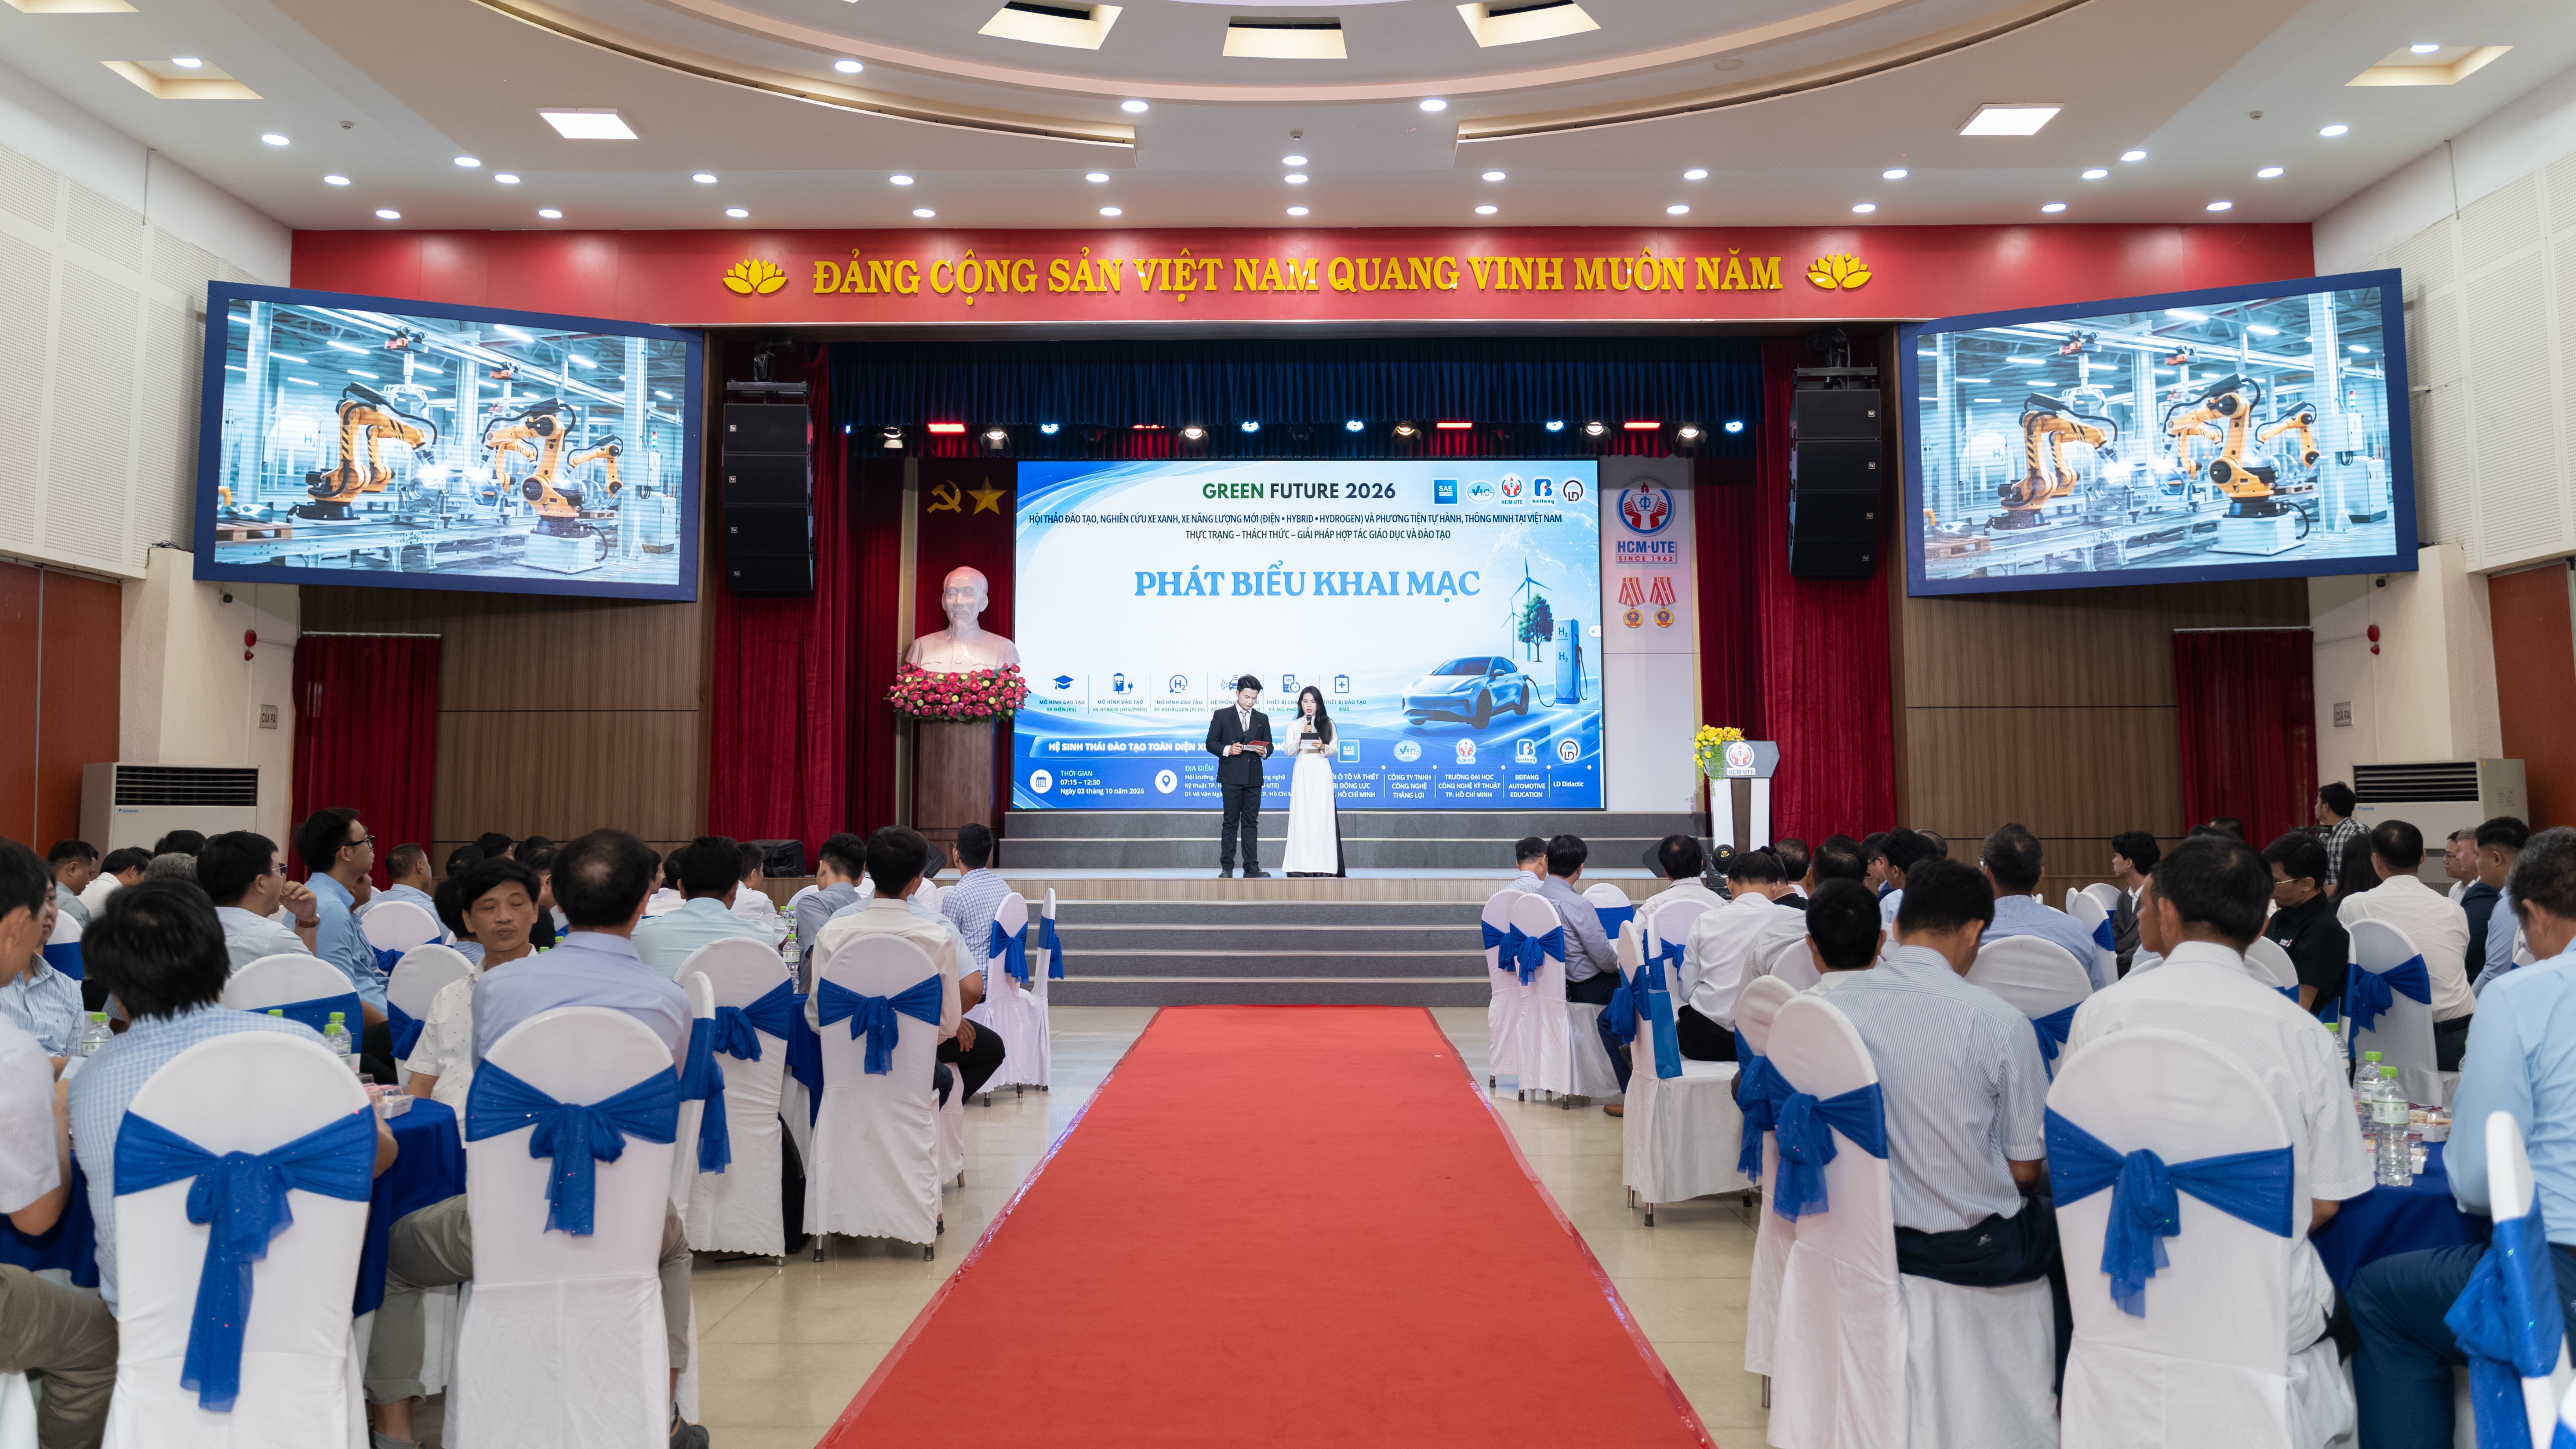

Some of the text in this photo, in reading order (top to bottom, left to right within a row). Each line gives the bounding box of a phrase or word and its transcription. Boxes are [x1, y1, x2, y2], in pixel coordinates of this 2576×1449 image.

[813, 247, 1784, 305] ĐẢNG CỘNG SẢN VIỆT NAM QUANG VINH MUÔN NĂM
[1203, 483, 1396, 499] GREEN FUTURE 2026
[1029, 512, 1043, 525] HỘI
[1043, 512, 1064, 523] THẢO
[1065, 512, 1081, 523] ĐÀO
[1082, 515, 1099, 525] TẠO,
[1101, 512, 1129, 523] NGHIÊN
[1130, 512, 1146, 523] CỨU
[1157, 515, 1180, 524] XANH,
[1192, 512, 1214, 523] NĂNG
[1215, 514, 1242, 525] LƯỢNG
[1243, 512, 1258, 523] MỚI
[1260, 512, 1280, 525] (ĐIỆN
[1320, 515, 1363, 524] HYDROGEN)
[1365, 512, 1375, 523] VÀ
[1376, 514, 1409, 523] PHƯƠNG
[1410, 512, 1426, 525] TIỆN
[1428, 514, 1439, 525] TỰ
[1440, 512, 1463, 523] HÀNH,
[1465, 512, 1491, 523] THÔNG
[1515, 515, 1526, 525] TẠI
[1527, 512, 1543, 525] VIỆT
[1186, 527, 1451, 541] THỰC TRẠNG THÁCH THỨC GIẢI PHÁP HỢP TÁC GIÁO DỤC VÀ ĐÀO TẠO
[1134, 560, 1480, 603] PHÁT BIỂU KHAI MẠC
[1048, 741, 1195, 752] HỆ SINH THÁI ĐÀO TẠO TOÀN DIỆN
[1362, 772, 1379, 780] THIẾT
[1086, 788, 1105, 796] tháng
